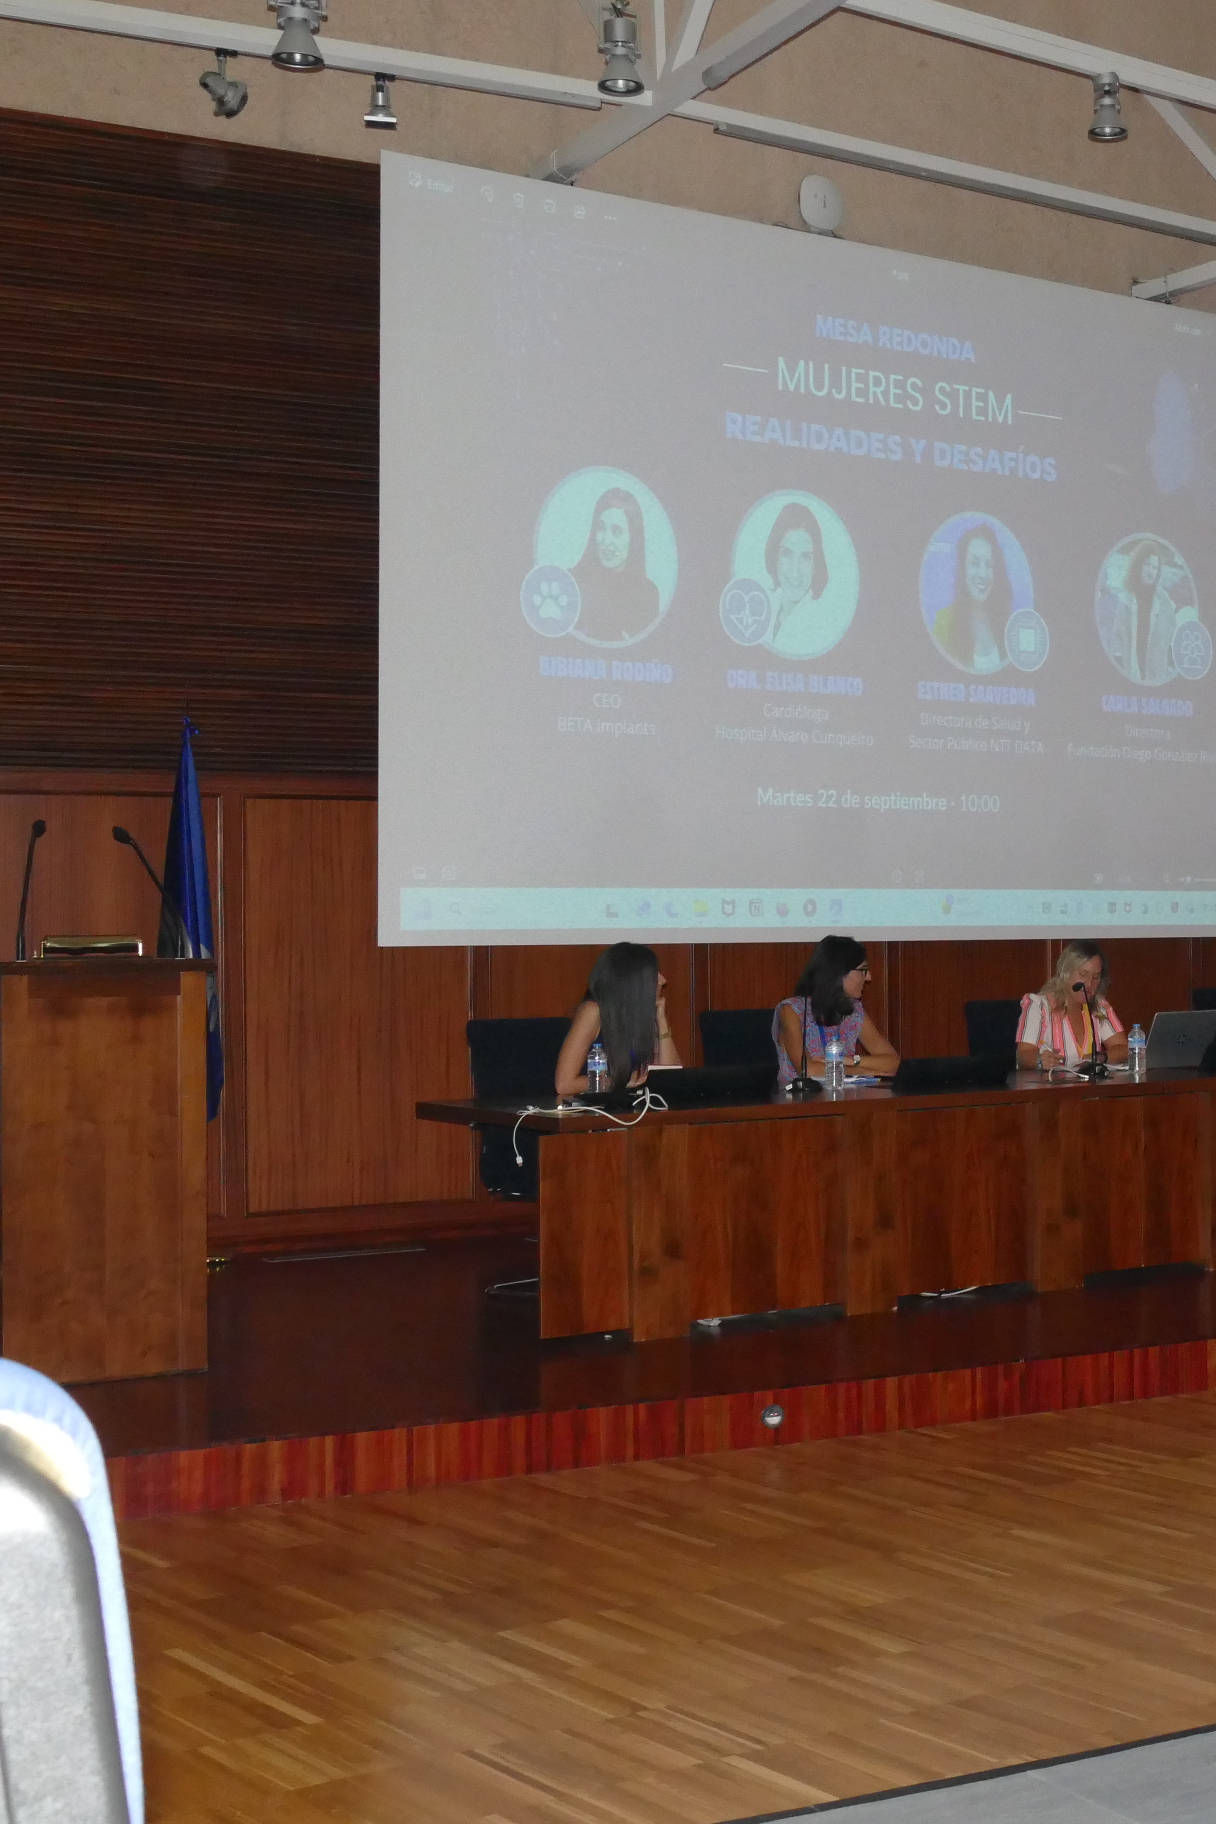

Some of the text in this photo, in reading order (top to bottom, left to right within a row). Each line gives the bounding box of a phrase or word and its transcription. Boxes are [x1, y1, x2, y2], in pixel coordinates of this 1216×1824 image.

[815, 314, 975, 363] MESA REDONDA
[777, 357, 1012, 425] MUJERES STEM
[725, 412, 1057, 482] REALIDADES Y DESAFÍOS
[765, 671, 805, 692] ELISA
[917, 681, 966, 702] ESTHER
[593, 693, 621, 708] CEO
[763, 703, 829, 723] Cardióloga
[920, 712, 1031, 734] Directora de Salud y
[557, 716, 593, 732] BETA
[1125, 724, 1171, 740] Directora
[715, 726, 766, 743] Hospital
[812, 730, 874, 747] Cunqueiro
[908, 734, 944, 750] Sector
[1014, 740, 1044, 755] DATA
[1068, 742, 1120, 759] Fundación
[1123, 746, 1151, 763] Diego
[757, 787, 813, 807] Martes
[817, 789, 837, 808] 22
[841, 789, 861, 809] de
[864, 791, 947, 812] septiembre
[960, 794, 1000, 812] 10:00
